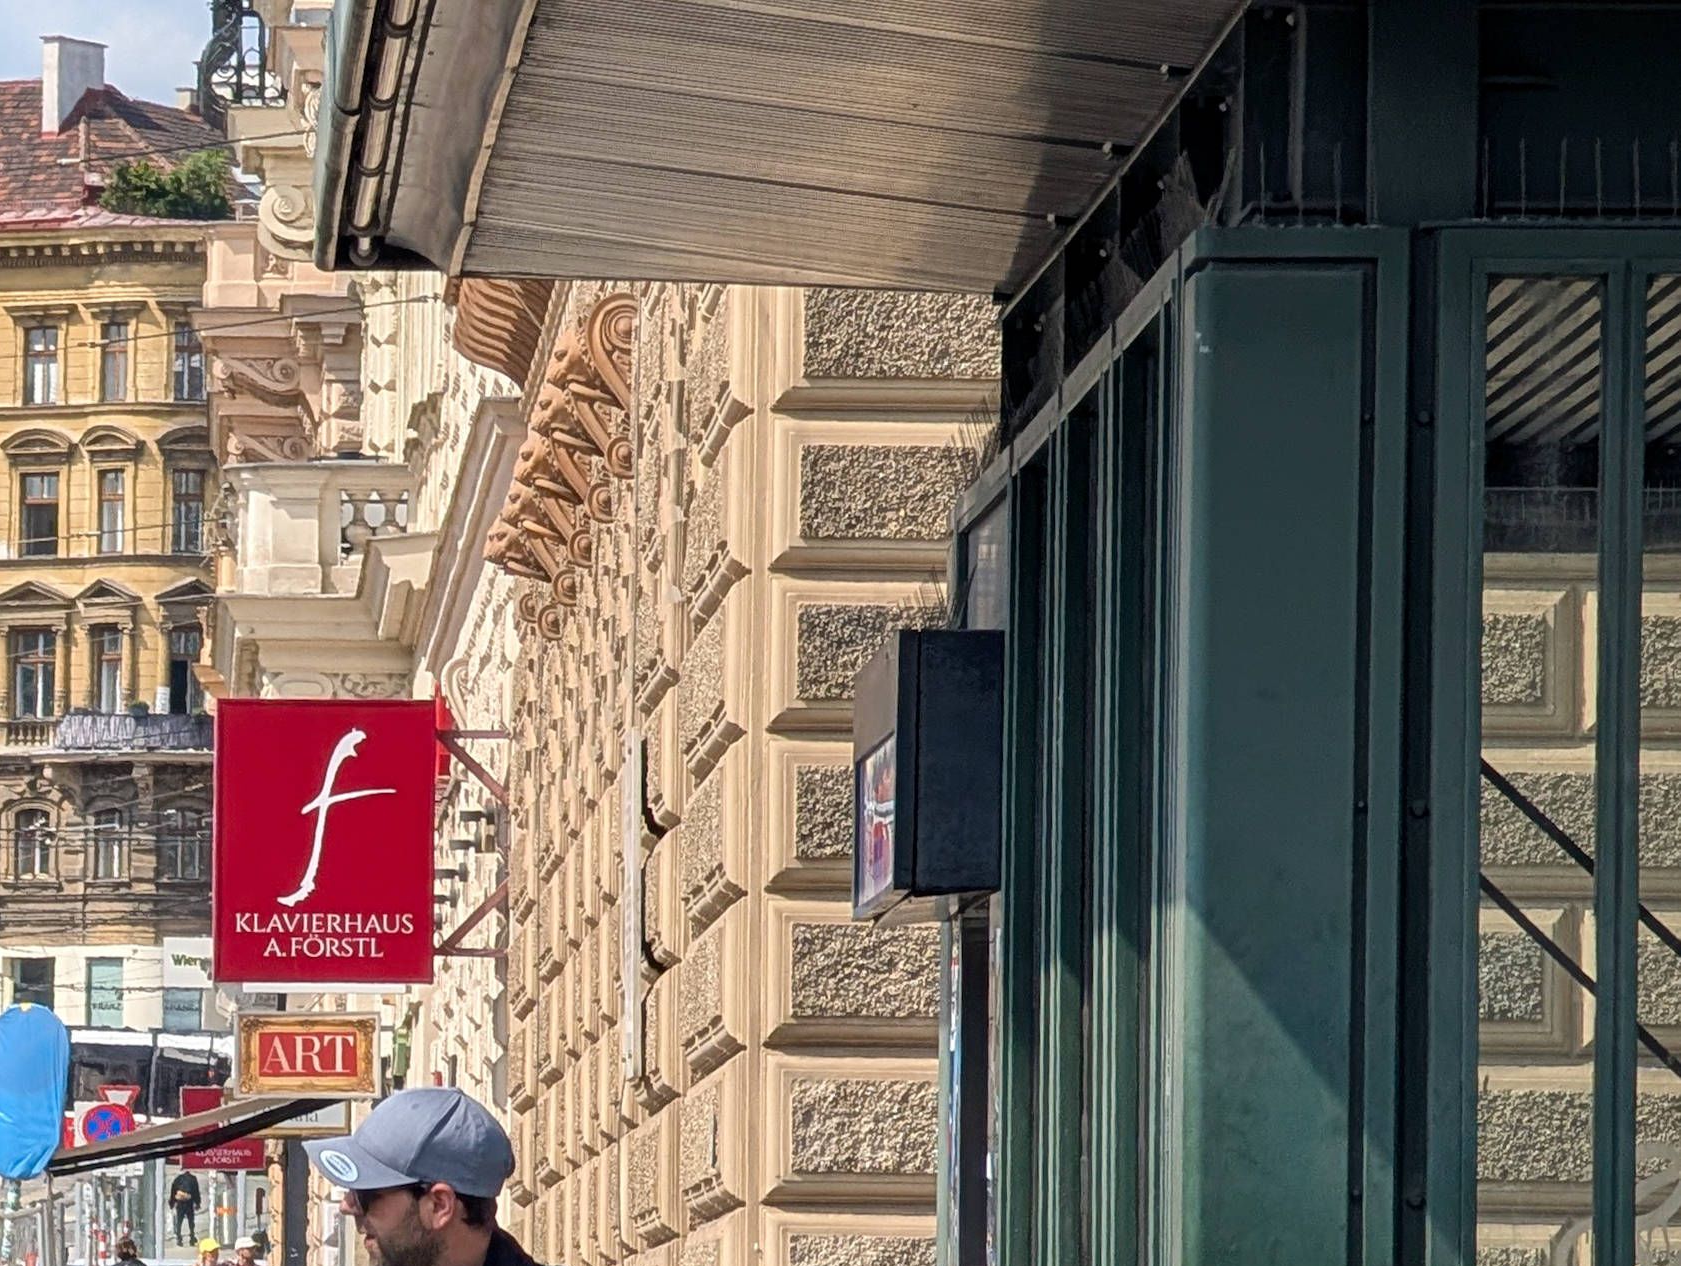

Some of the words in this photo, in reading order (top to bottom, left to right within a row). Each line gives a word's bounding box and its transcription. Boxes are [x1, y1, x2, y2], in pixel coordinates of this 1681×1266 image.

[234, 912, 415, 935] KLAVIERHAUS
[290, 933, 384, 958] FÖRSTL
[261, 1034, 355, 1074] ART
